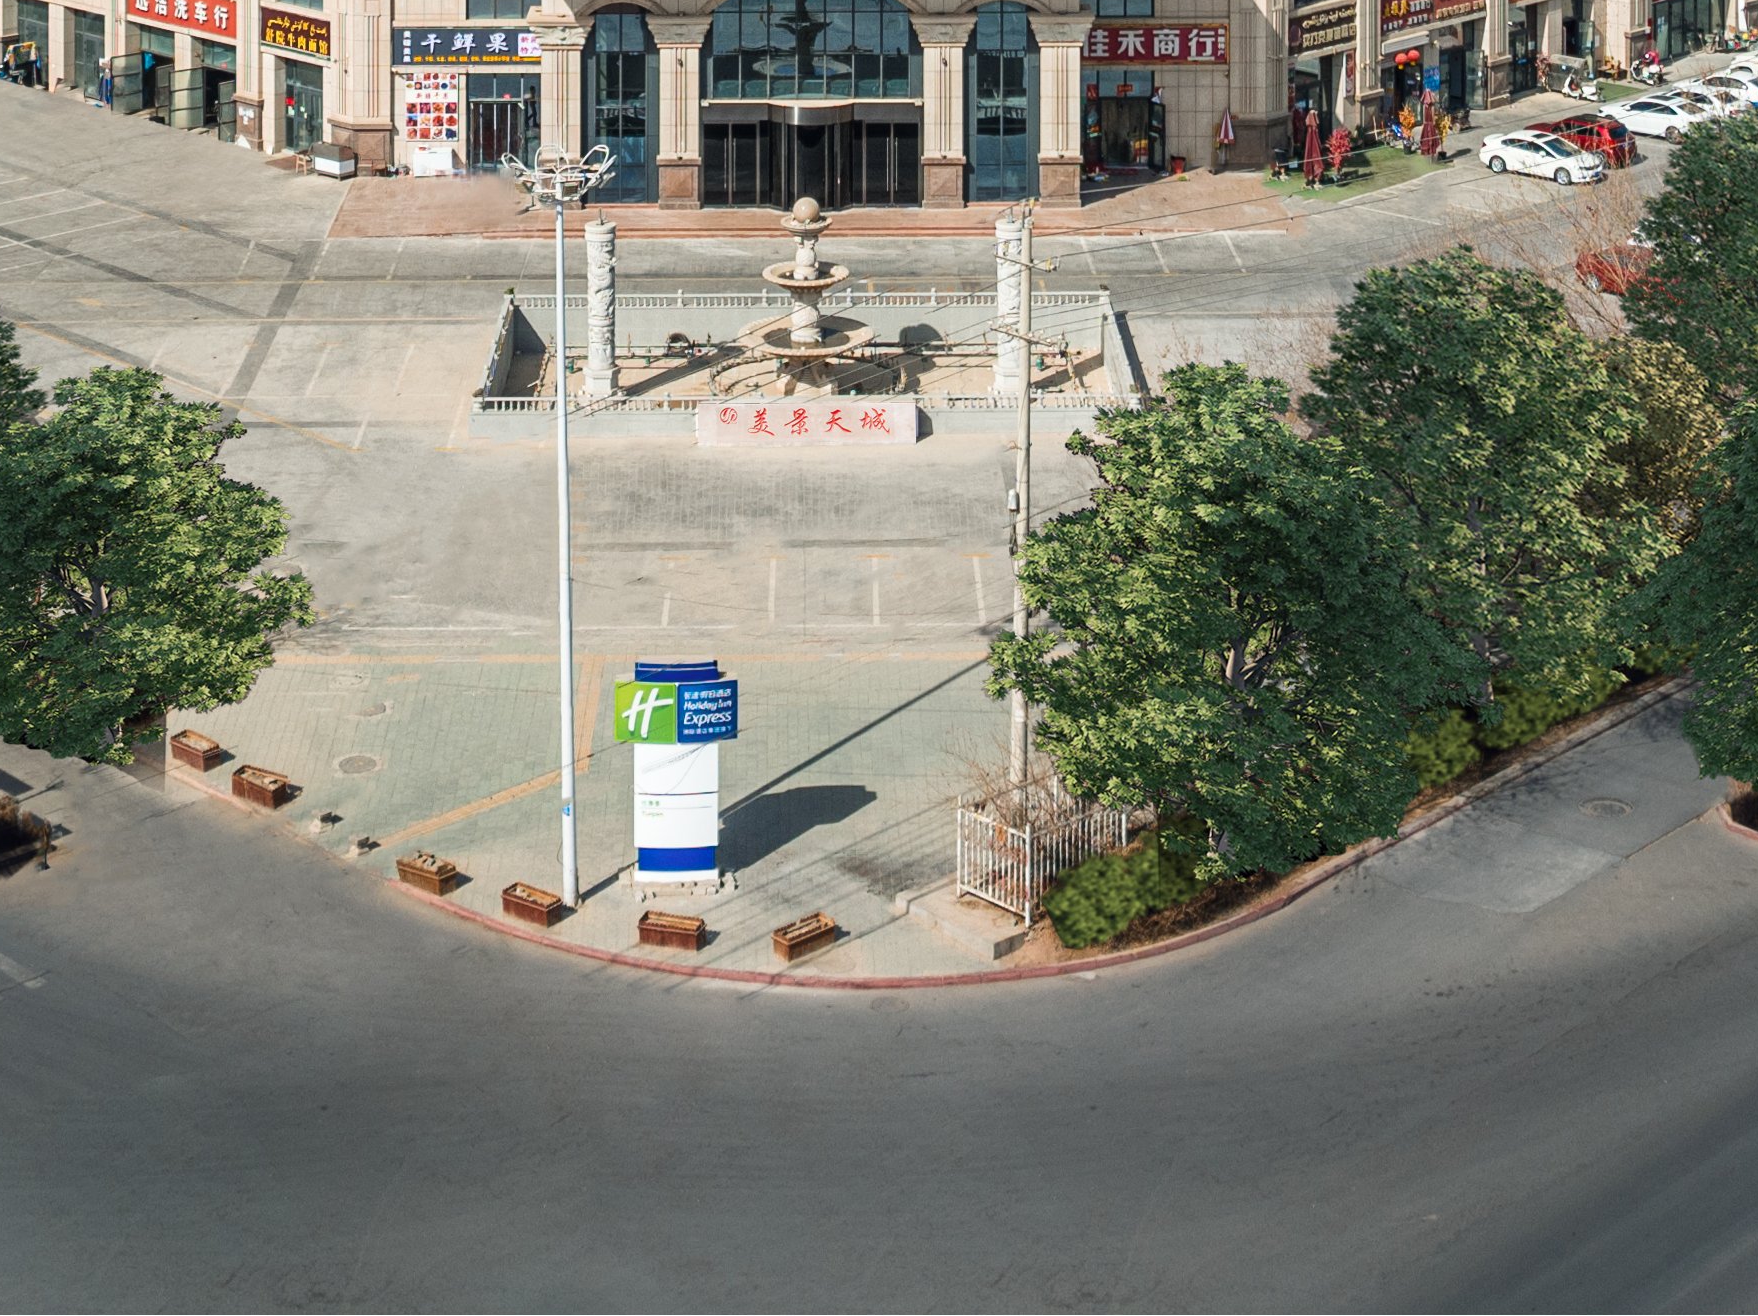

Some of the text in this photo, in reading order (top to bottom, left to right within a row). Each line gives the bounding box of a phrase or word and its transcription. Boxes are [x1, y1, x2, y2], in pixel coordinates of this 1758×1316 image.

[420, 32, 509, 55] 干鲜果
[1083, 29, 1215, 60] 佳禾商行
[747, 408, 890, 436] 美景天城
[683, 701, 717, 713] Holiday
[683, 711, 732, 727] Express
